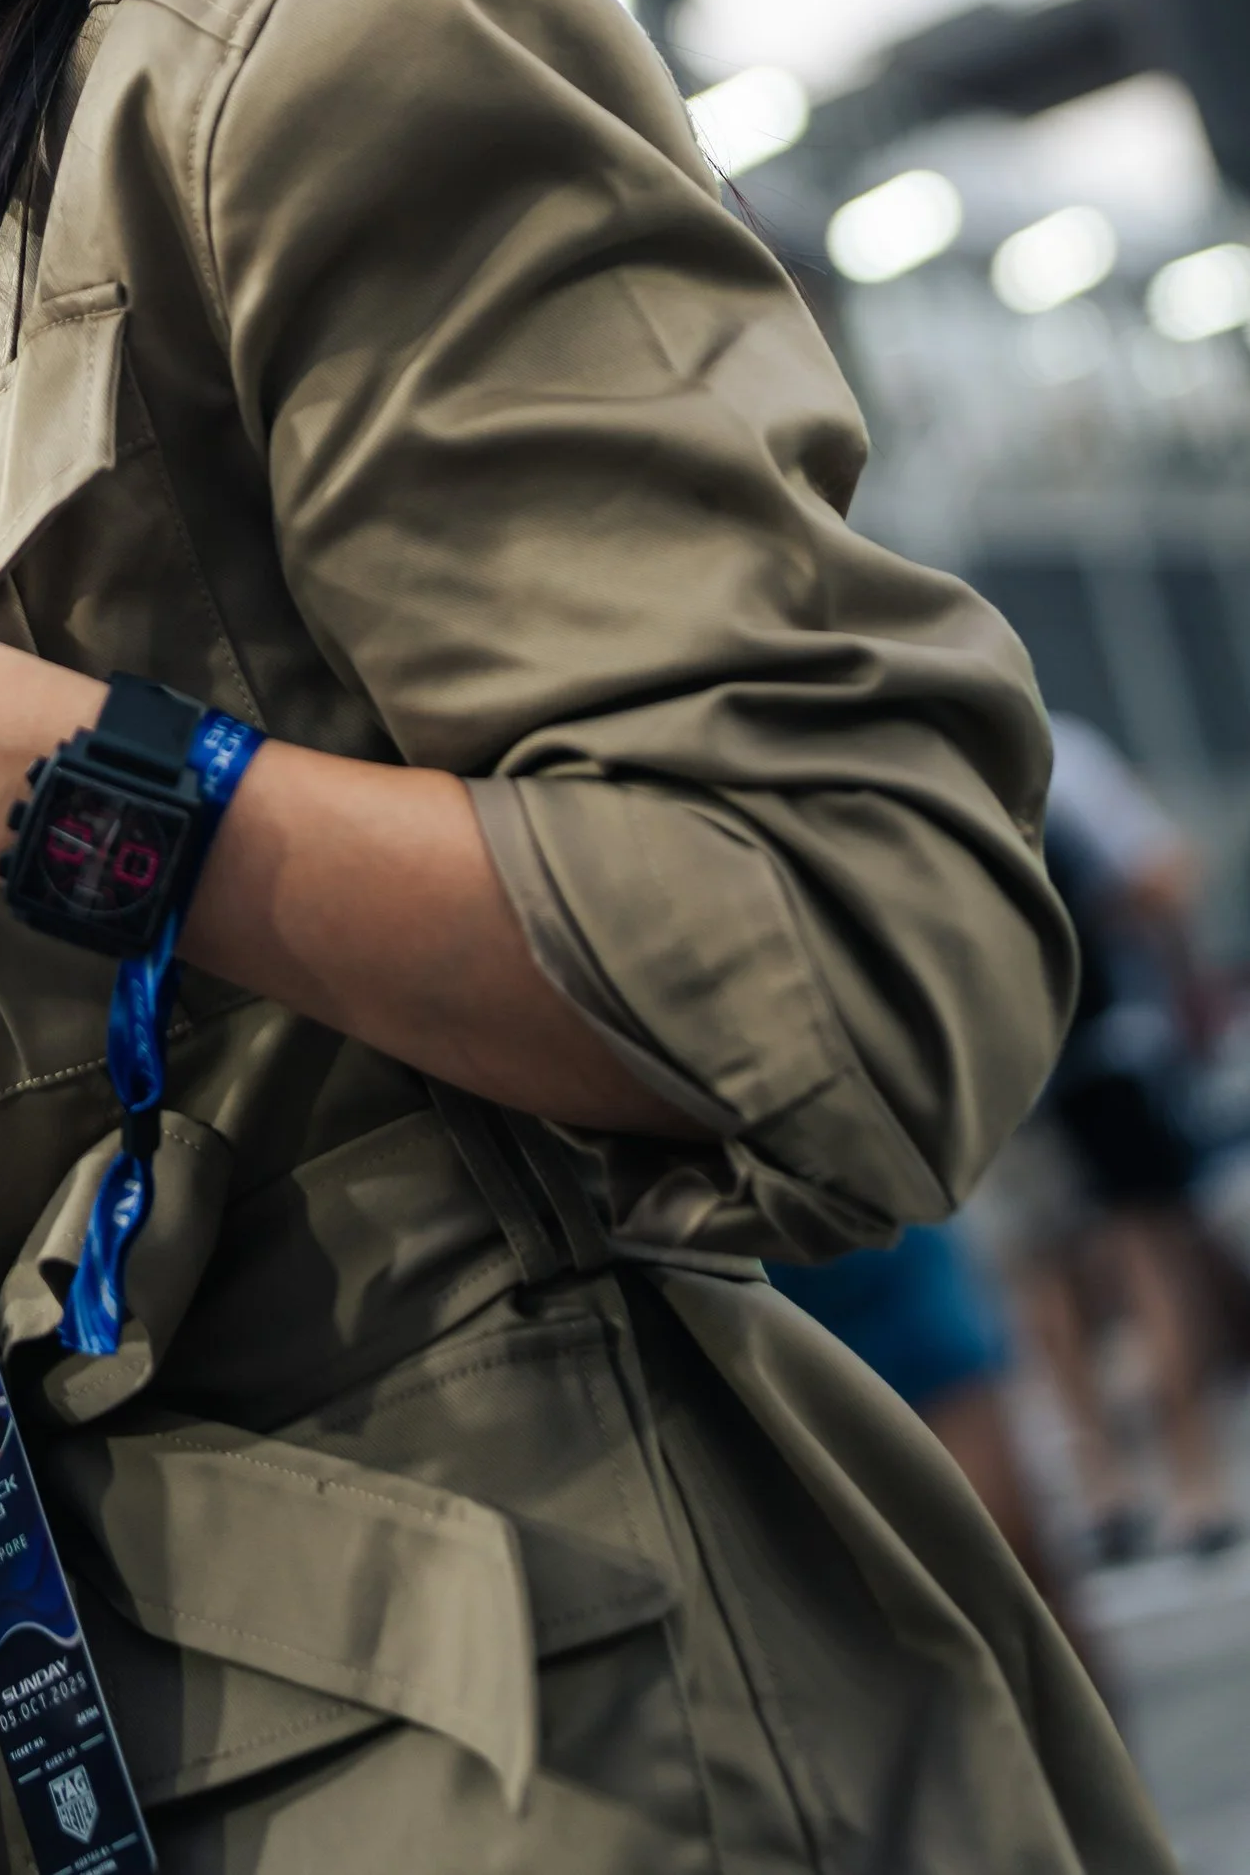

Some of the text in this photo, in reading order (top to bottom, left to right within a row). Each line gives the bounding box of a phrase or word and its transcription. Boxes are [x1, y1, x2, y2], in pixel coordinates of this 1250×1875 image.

[0, 1671, 87, 1733] 05.OCT.2025
[1, 1655, 69, 1706] SUNDAY
[52, 1771, 89, 1805] TAG
